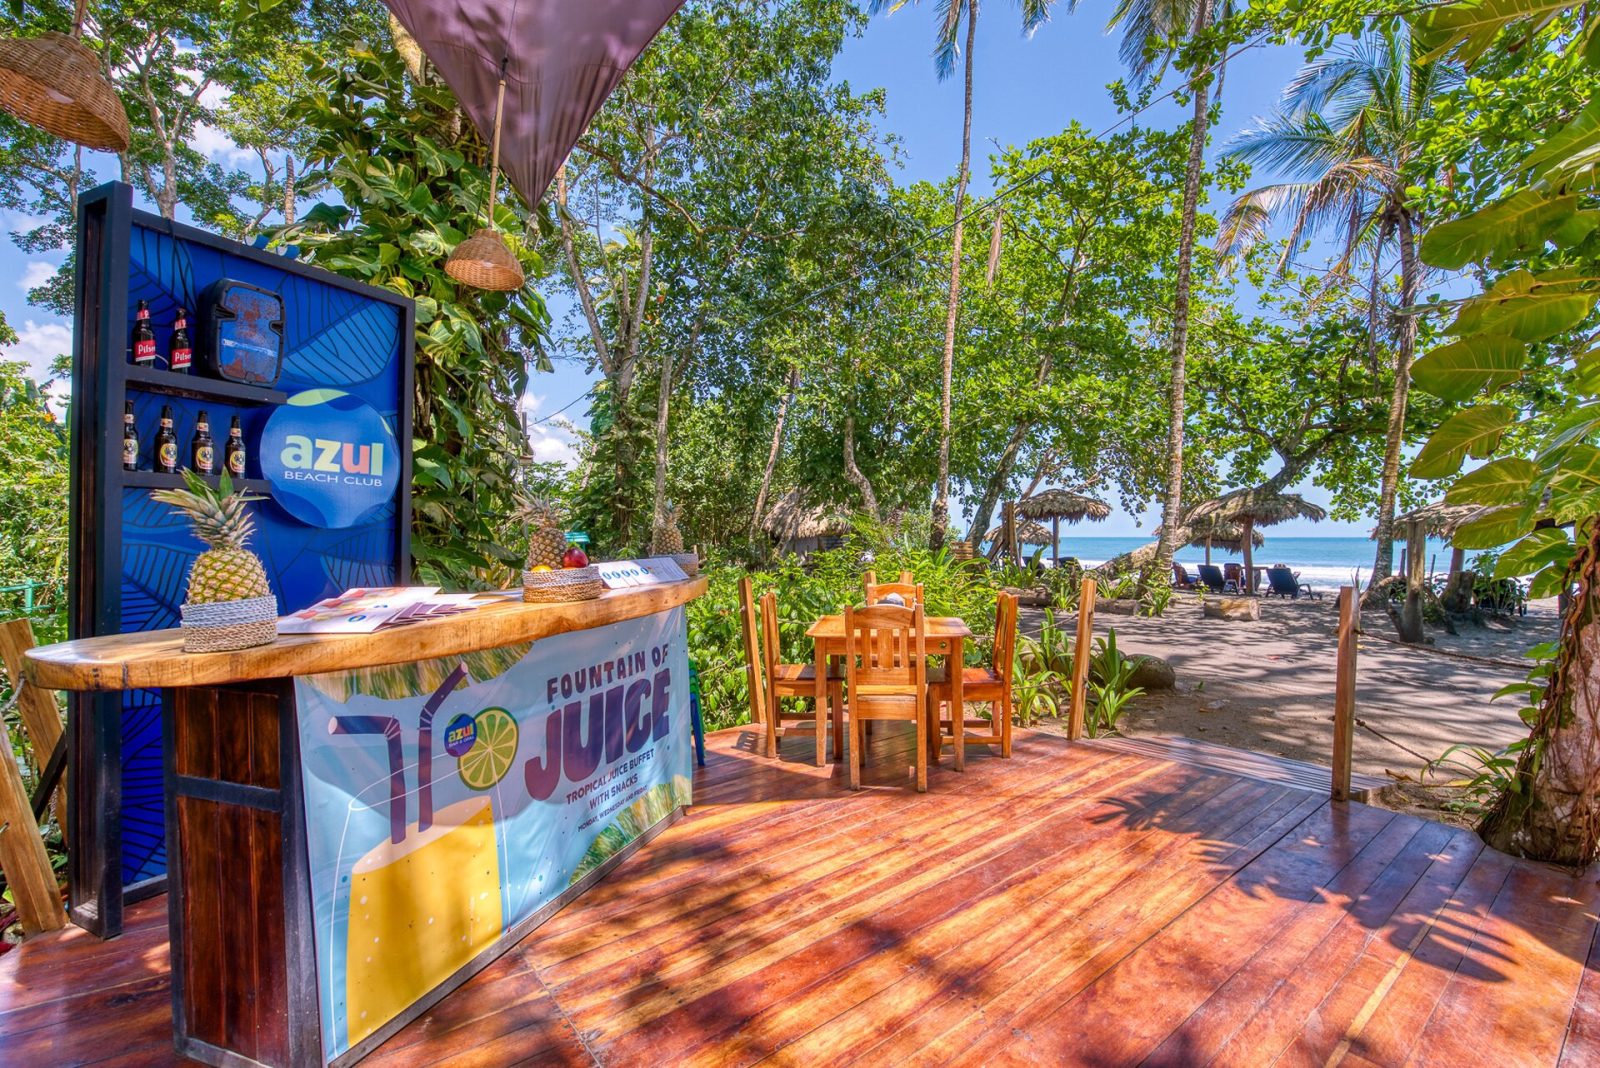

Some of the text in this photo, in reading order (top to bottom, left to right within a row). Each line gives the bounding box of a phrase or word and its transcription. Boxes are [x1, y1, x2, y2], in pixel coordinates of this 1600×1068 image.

[280, 434, 384, 477] azul
[284, 470, 383, 487] BEACH CLUB
[547, 643, 670, 704] FOUNTAIN OF
[447, 723, 474, 743] azul
[524, 668, 671, 802] JUICE
[566, 748, 655, 805] TROPICAL JUICE BUFFET
[589, 773, 638, 810] WITH SNACKS
[598, 799, 625, 819] WEDNESDAY
